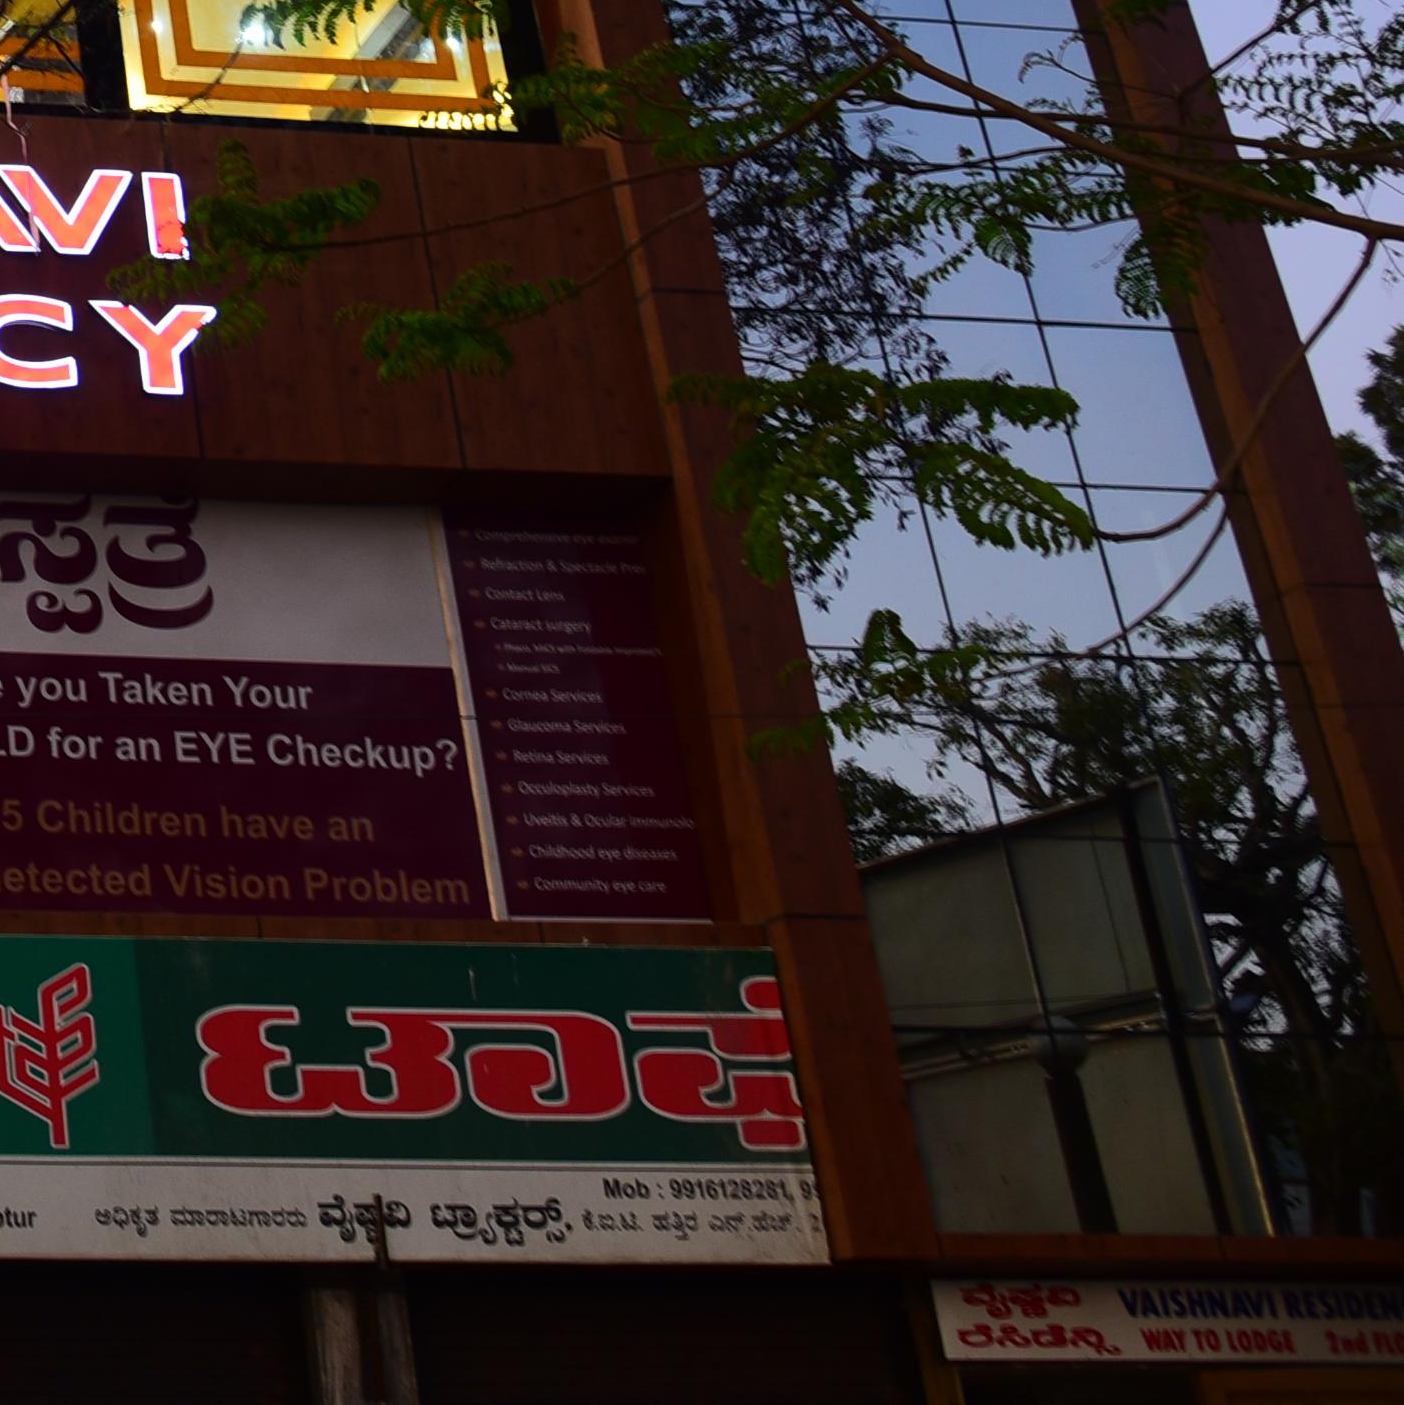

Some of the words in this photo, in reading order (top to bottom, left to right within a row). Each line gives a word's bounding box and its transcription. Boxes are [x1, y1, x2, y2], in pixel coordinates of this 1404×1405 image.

[484, 587, 535, 602] Contact
[490, 616, 541, 632] Cataract
[16, 675, 88, 709] you
[99, 672, 212, 708] Taken
[221, 676, 312, 711] Your
[502, 688, 548, 703] Cornea
[551, 689, 603, 704] Services
[506, 717, 572, 734] Glaucoma
[574, 719, 627, 735] Services
[47, 727, 104, 761] for
[114, 737, 162, 763] an
[174, 731, 255, 766] EYE
[266, 735, 459, 778] Checkup?
[513, 749, 555, 764] Retina
[557, 750, 609, 765] Services
[601, 782, 656, 797] Services
[1, 800, 23, 832] 5
[36, 801, 207, 838] Children
[220, 807, 312, 840] have
[326, 817, 374, 841] an
[584, 813, 627, 828] Ocular
[528, 844, 595, 860] Childhood
[597, 849, 622, 863] eye
[624, 845, 680, 862] diseases
[164, 863, 291, 900] Vision
[304, 868, 470, 904] Problem
[533, 876, 609, 893] Community
[612, 880, 636, 894] eye
[638, 881, 668, 893] care
[603, 1177, 649, 1200] Mob
[1117, 1287, 1275, 1320] VAISHNAVI
[1140, 1327, 1185, 1353] WAY
[1192, 1329, 1220, 1352] TO
[1227, 1329, 1296, 1355] LODGE
[1326, 1331, 1366, 1355] 2nd
